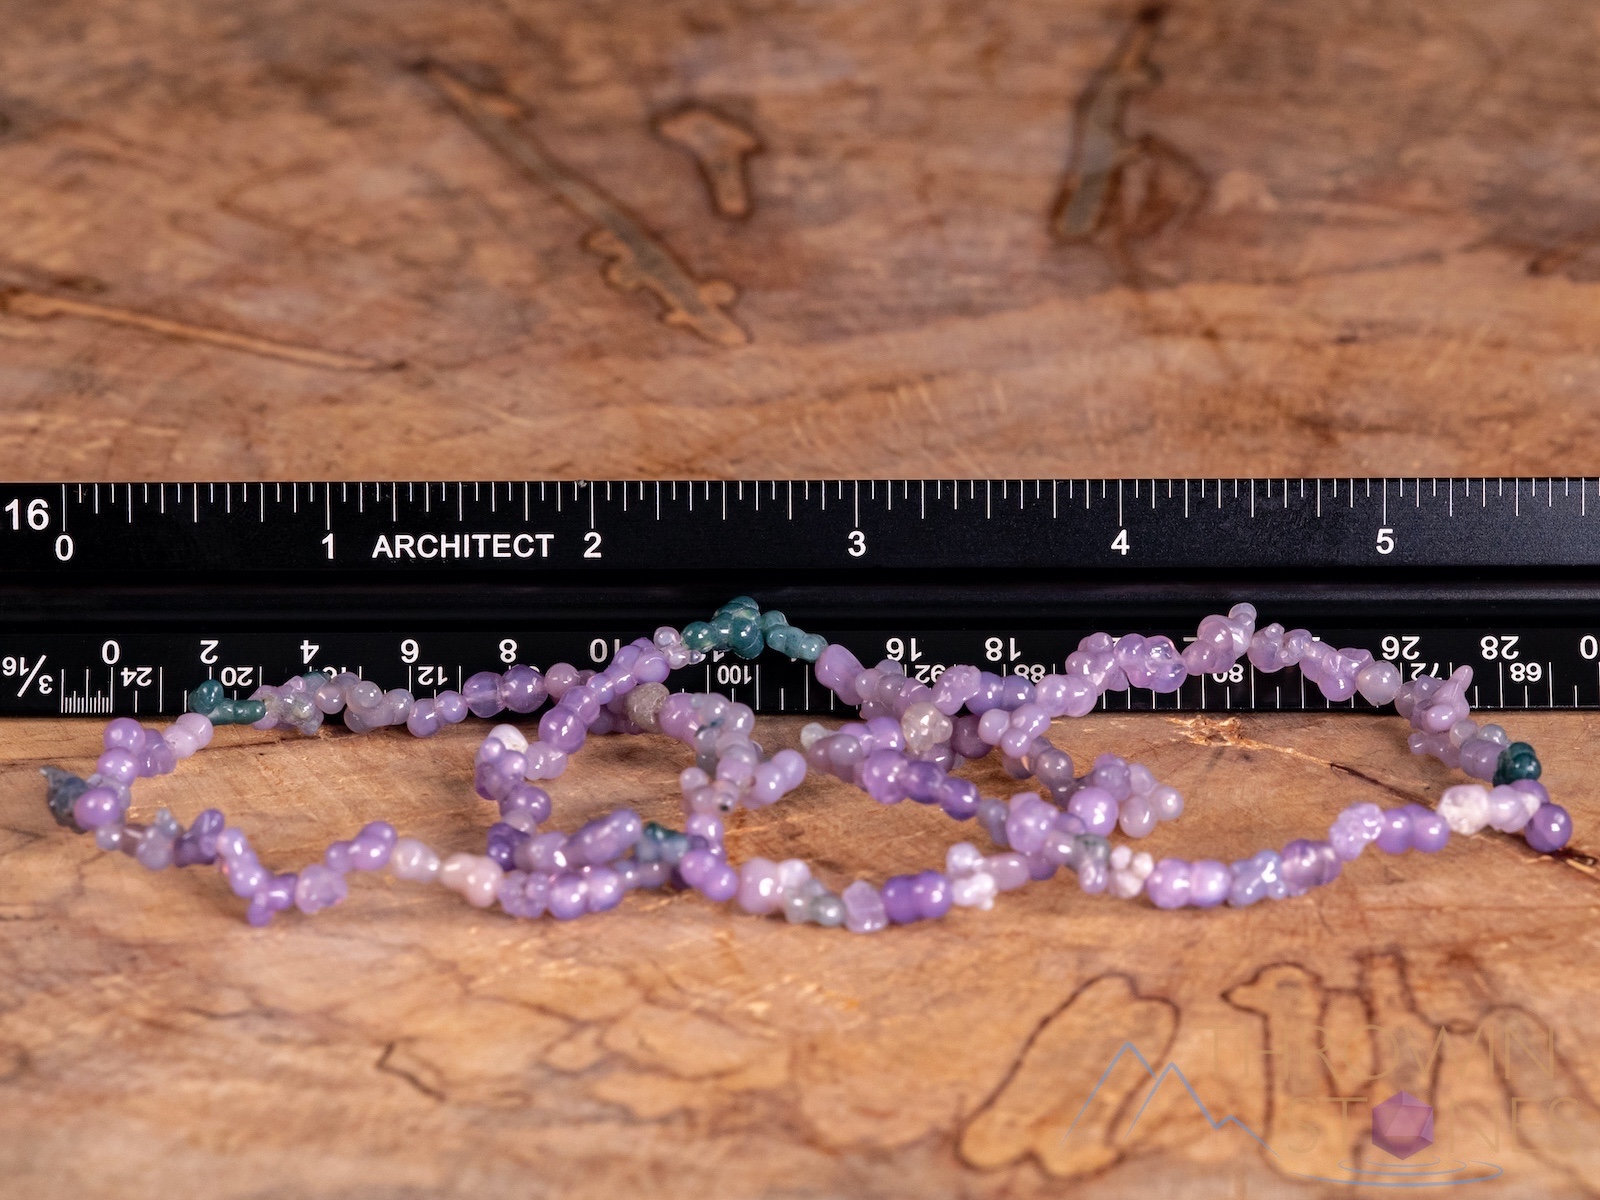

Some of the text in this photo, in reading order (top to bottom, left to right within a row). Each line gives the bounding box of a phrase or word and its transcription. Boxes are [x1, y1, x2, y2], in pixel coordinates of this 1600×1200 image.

[4, 498, 50, 531] 16
[54, 528, 1395, 561] 0 1 ARCHITECT 2 3 4 5
[101, 639, 121, 665] 0
[199, 639, 219, 664] 2
[299, 639, 320, 665] 4
[499, 638, 517, 663] 8
[885, 637, 923, 662] 16
[984, 637, 1022, 662] 18
[1381, 635, 1421, 660] 26
[1479, 635, 1520, 660] 28
[120, 666, 153, 687] 24
[220, 666, 253, 687] 20
[417, 665, 448, 686] 12
[716, 664, 752, 685] 100
[1508, 662, 1543, 682] 68
